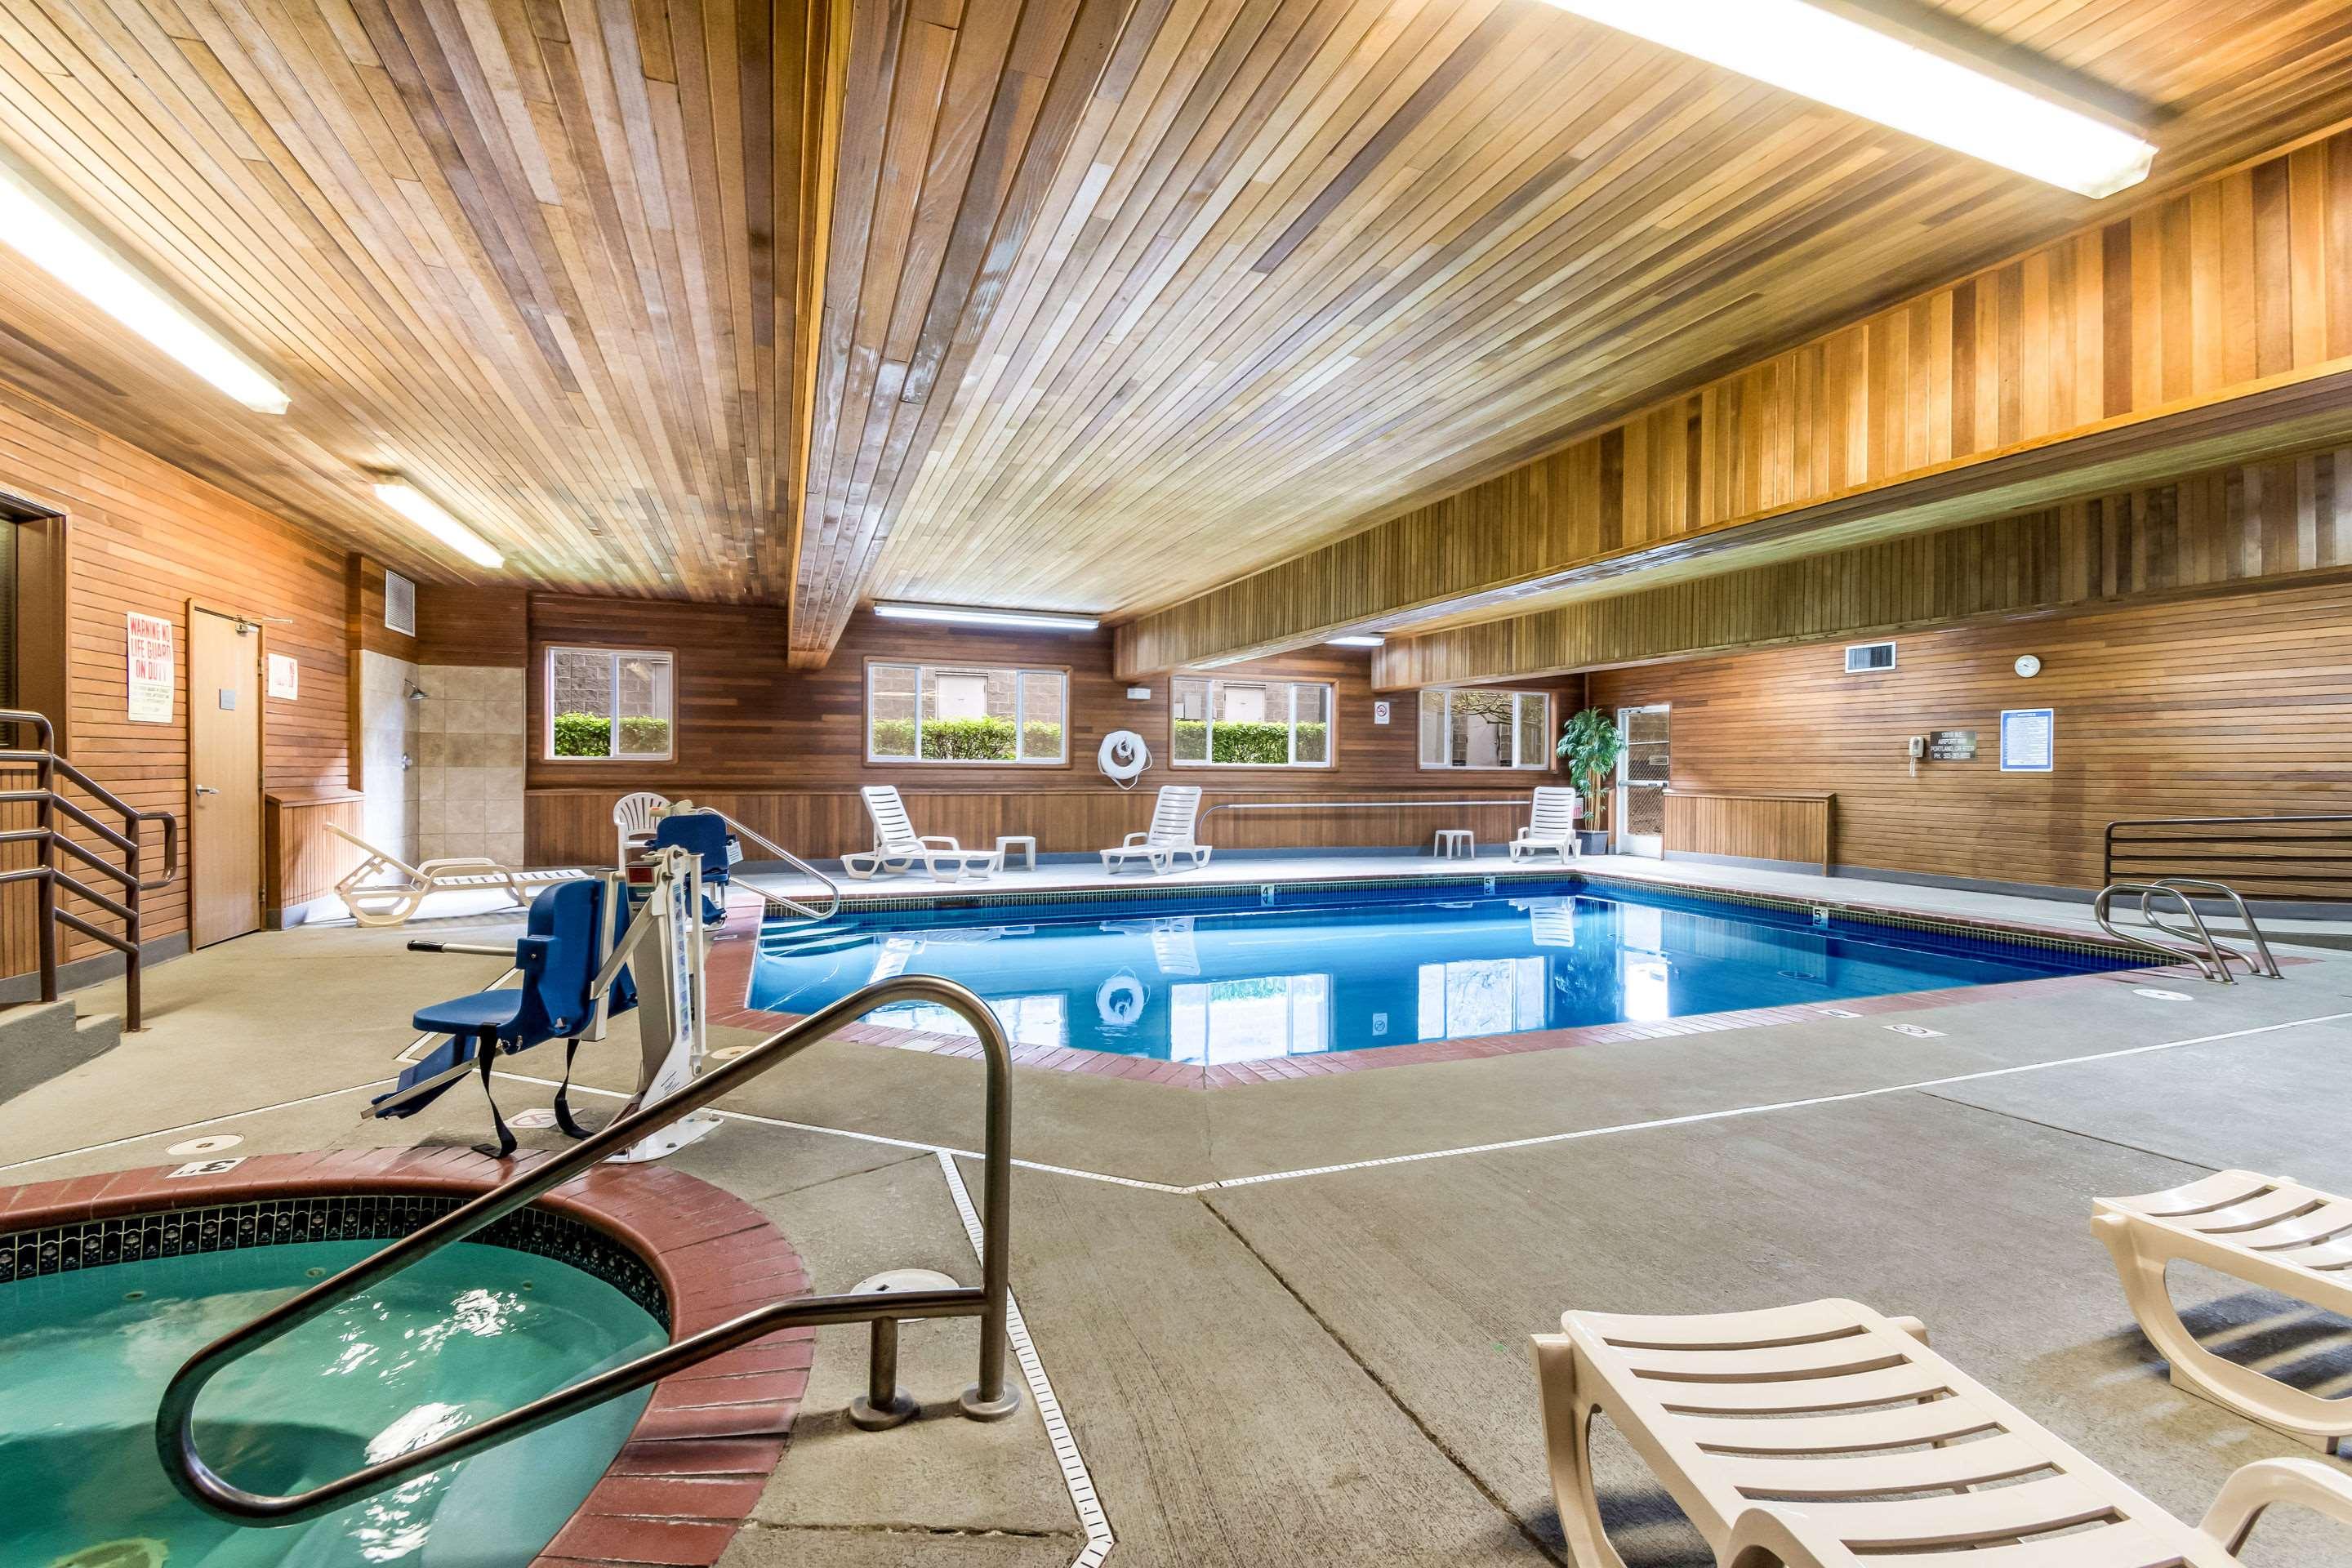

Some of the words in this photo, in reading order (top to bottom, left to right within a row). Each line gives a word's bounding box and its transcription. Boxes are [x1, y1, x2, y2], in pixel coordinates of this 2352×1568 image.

[130, 617, 160, 640] WARNING
[162, 624, 170, 642] NO
[131, 638, 145, 657] LIFE
[147, 641, 172, 661] GUARD
[136, 659, 146, 679] ON
[148, 662, 168, 681] DUTY
[1263, 886, 1268, 895] 4
[1814, 908, 1821, 917] 5
